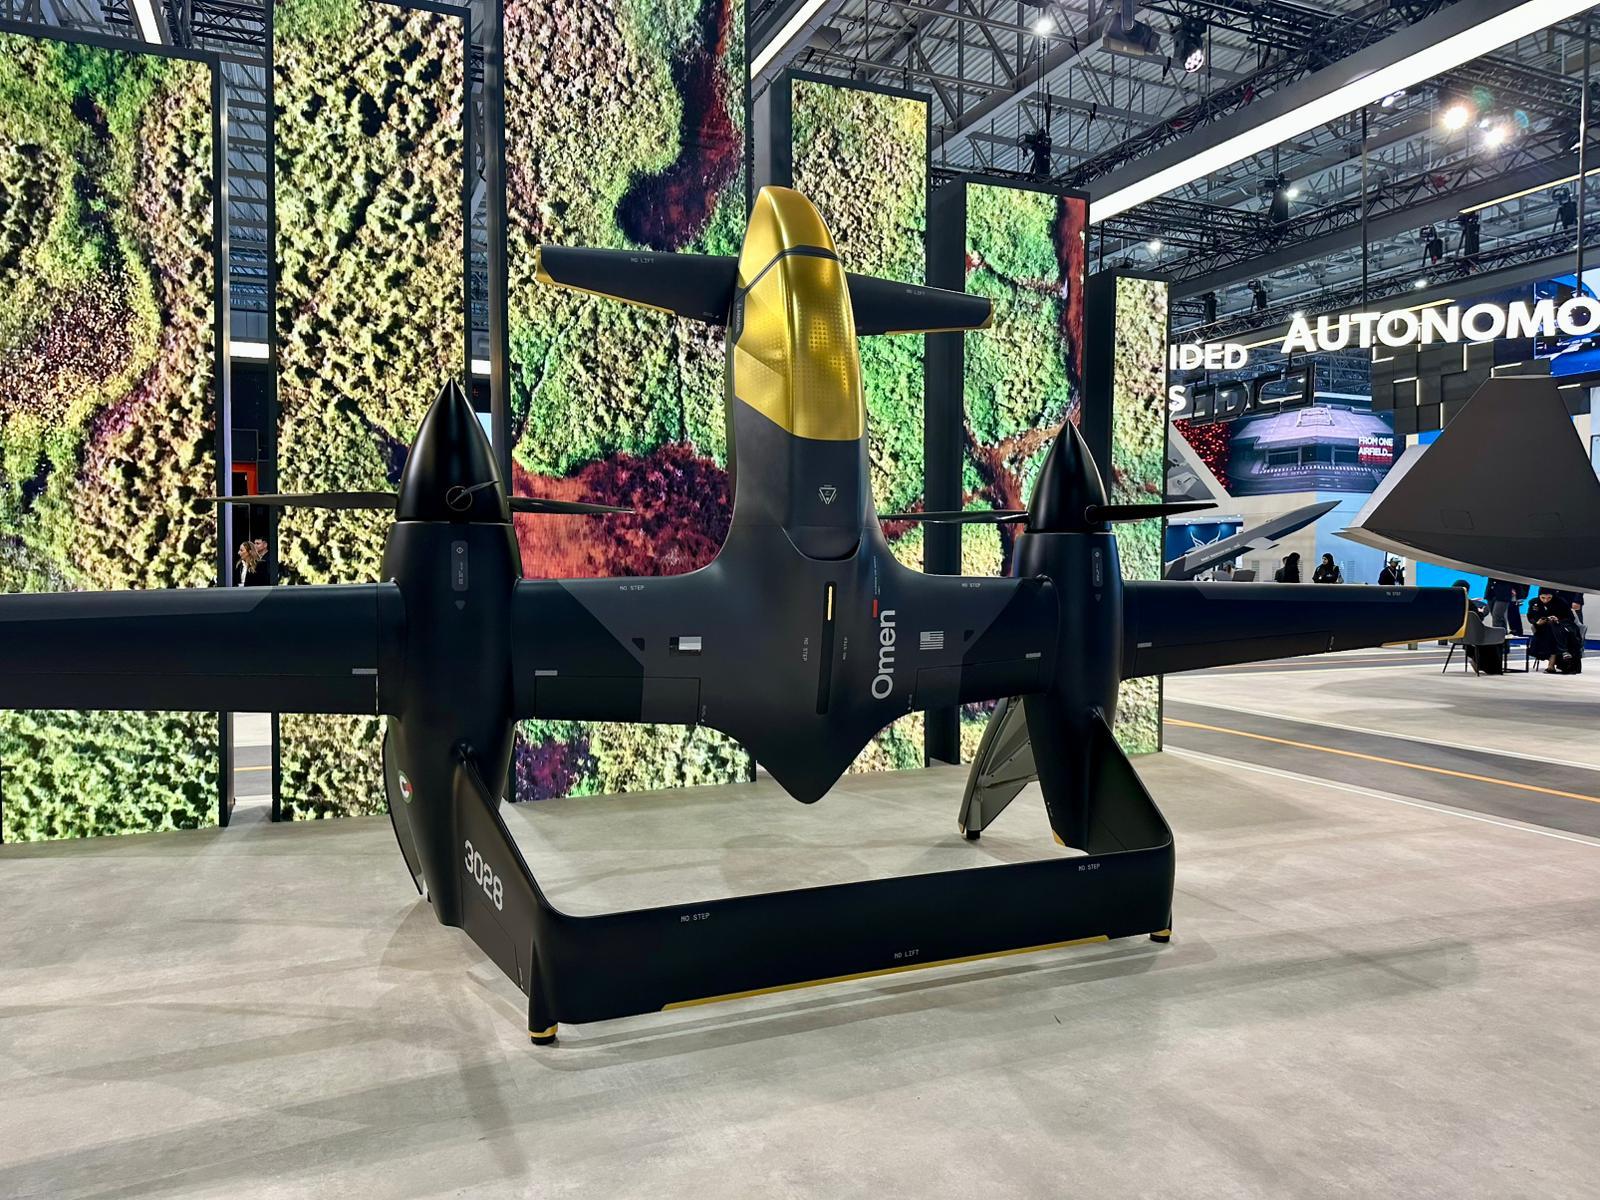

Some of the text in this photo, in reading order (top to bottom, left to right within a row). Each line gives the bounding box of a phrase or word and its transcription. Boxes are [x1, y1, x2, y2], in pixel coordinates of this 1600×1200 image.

[1359, 436, 1394, 447] FROM ONE
[871, 609, 896, 700] Omen
[1087, 862, 1101, 871] STEP
[464, 839, 504, 912] 3028
[692, 912, 710, 921] STEP
